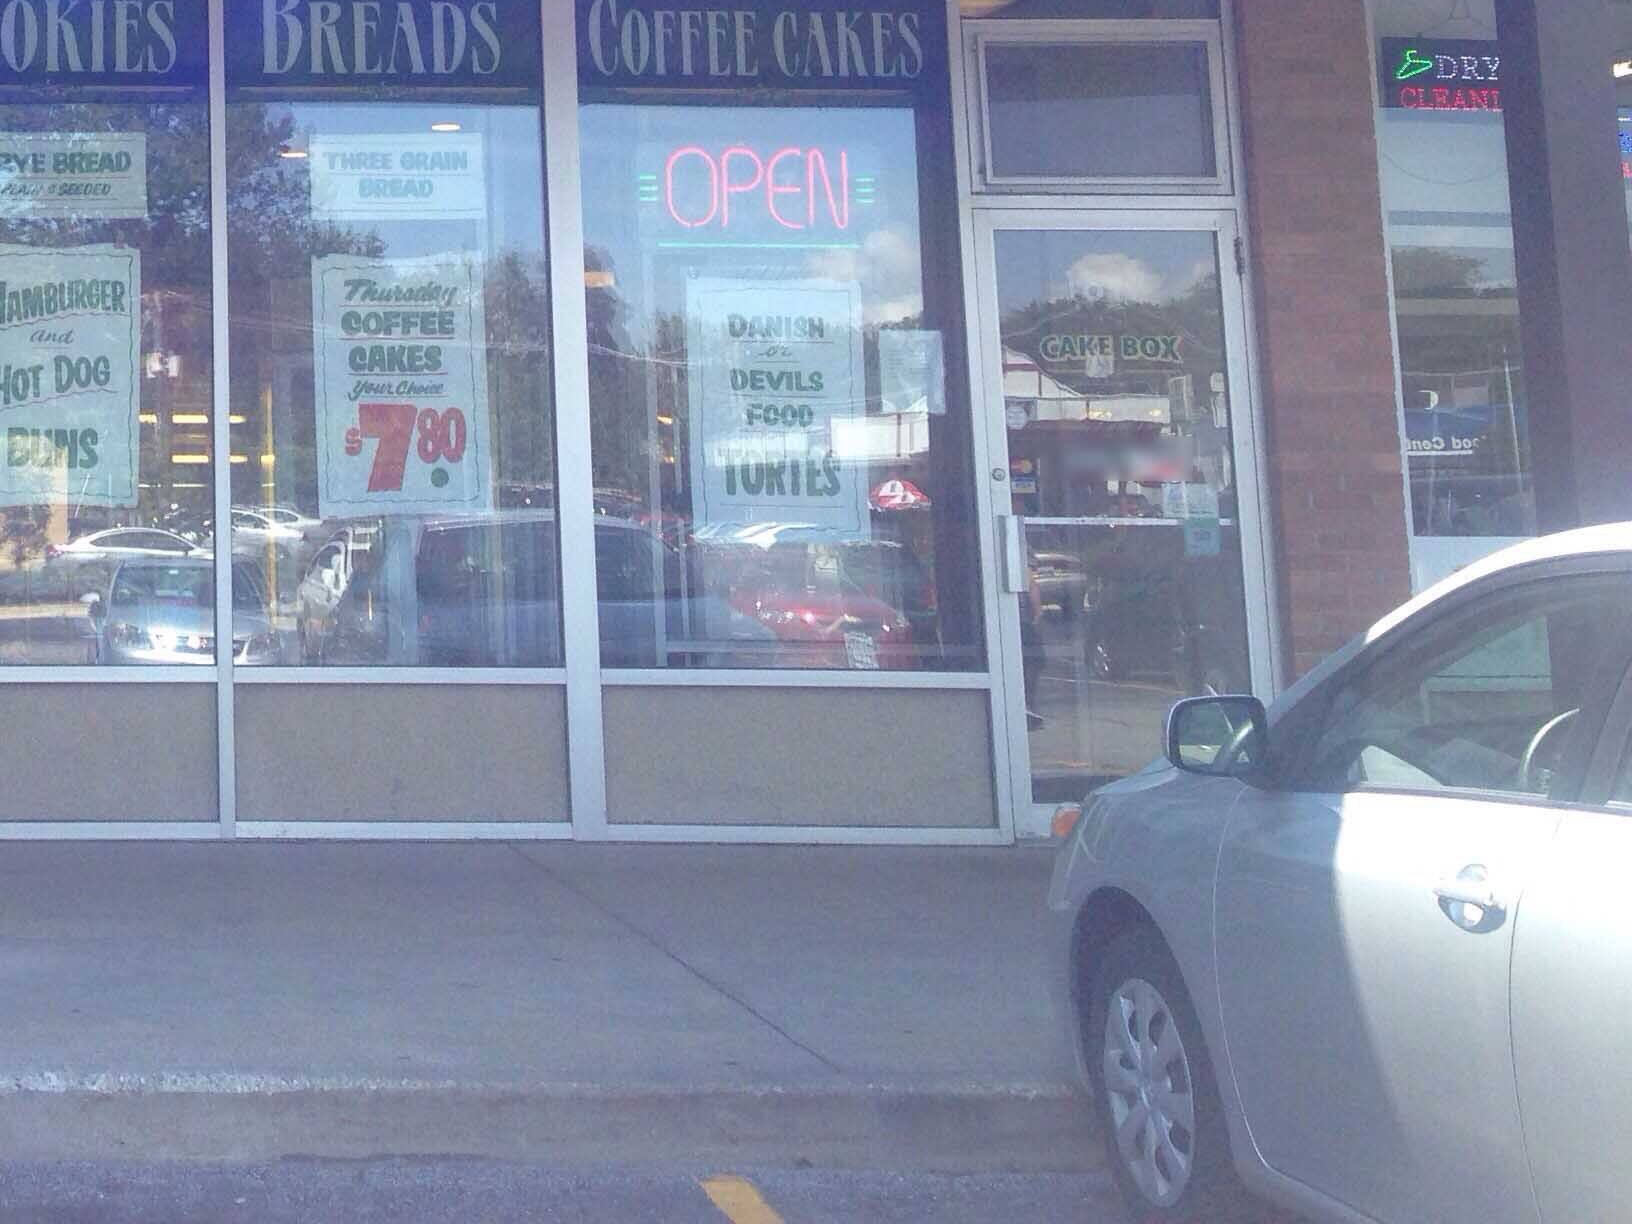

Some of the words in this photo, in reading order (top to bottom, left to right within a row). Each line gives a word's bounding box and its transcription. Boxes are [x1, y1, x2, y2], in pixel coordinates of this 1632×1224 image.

[773, 11, 923, 77] CAKES
[1435, 55, 1500, 80] DRY
[1400, 88, 1504, 112] CLEANI
[53, 151, 131, 174] BREAD
[325, 152, 394, 172] THREE
[400, 151, 468, 172] GRAIN
[358, 178, 433, 199] BREAD
[666, 145, 848, 228] OPEN
[344, 278, 458, 306] Thursday
[341, 311, 455, 336] COFFEE
[727, 313, 825, 338] DANISH
[29, 328, 74, 345] and
[1039, 335, 1113, 361] CAKE
[1120, 335, 1184, 363] BOX
[349, 345, 442, 372] CAKES
[54, 355, 111, 393] DOG
[730, 368, 824, 392] DEVILS
[347, 380, 394, 401] Your
[396, 380, 444, 395] Choice
[744, 403, 814, 428] FOOD
[7, 427, 98, 469] BUNS
